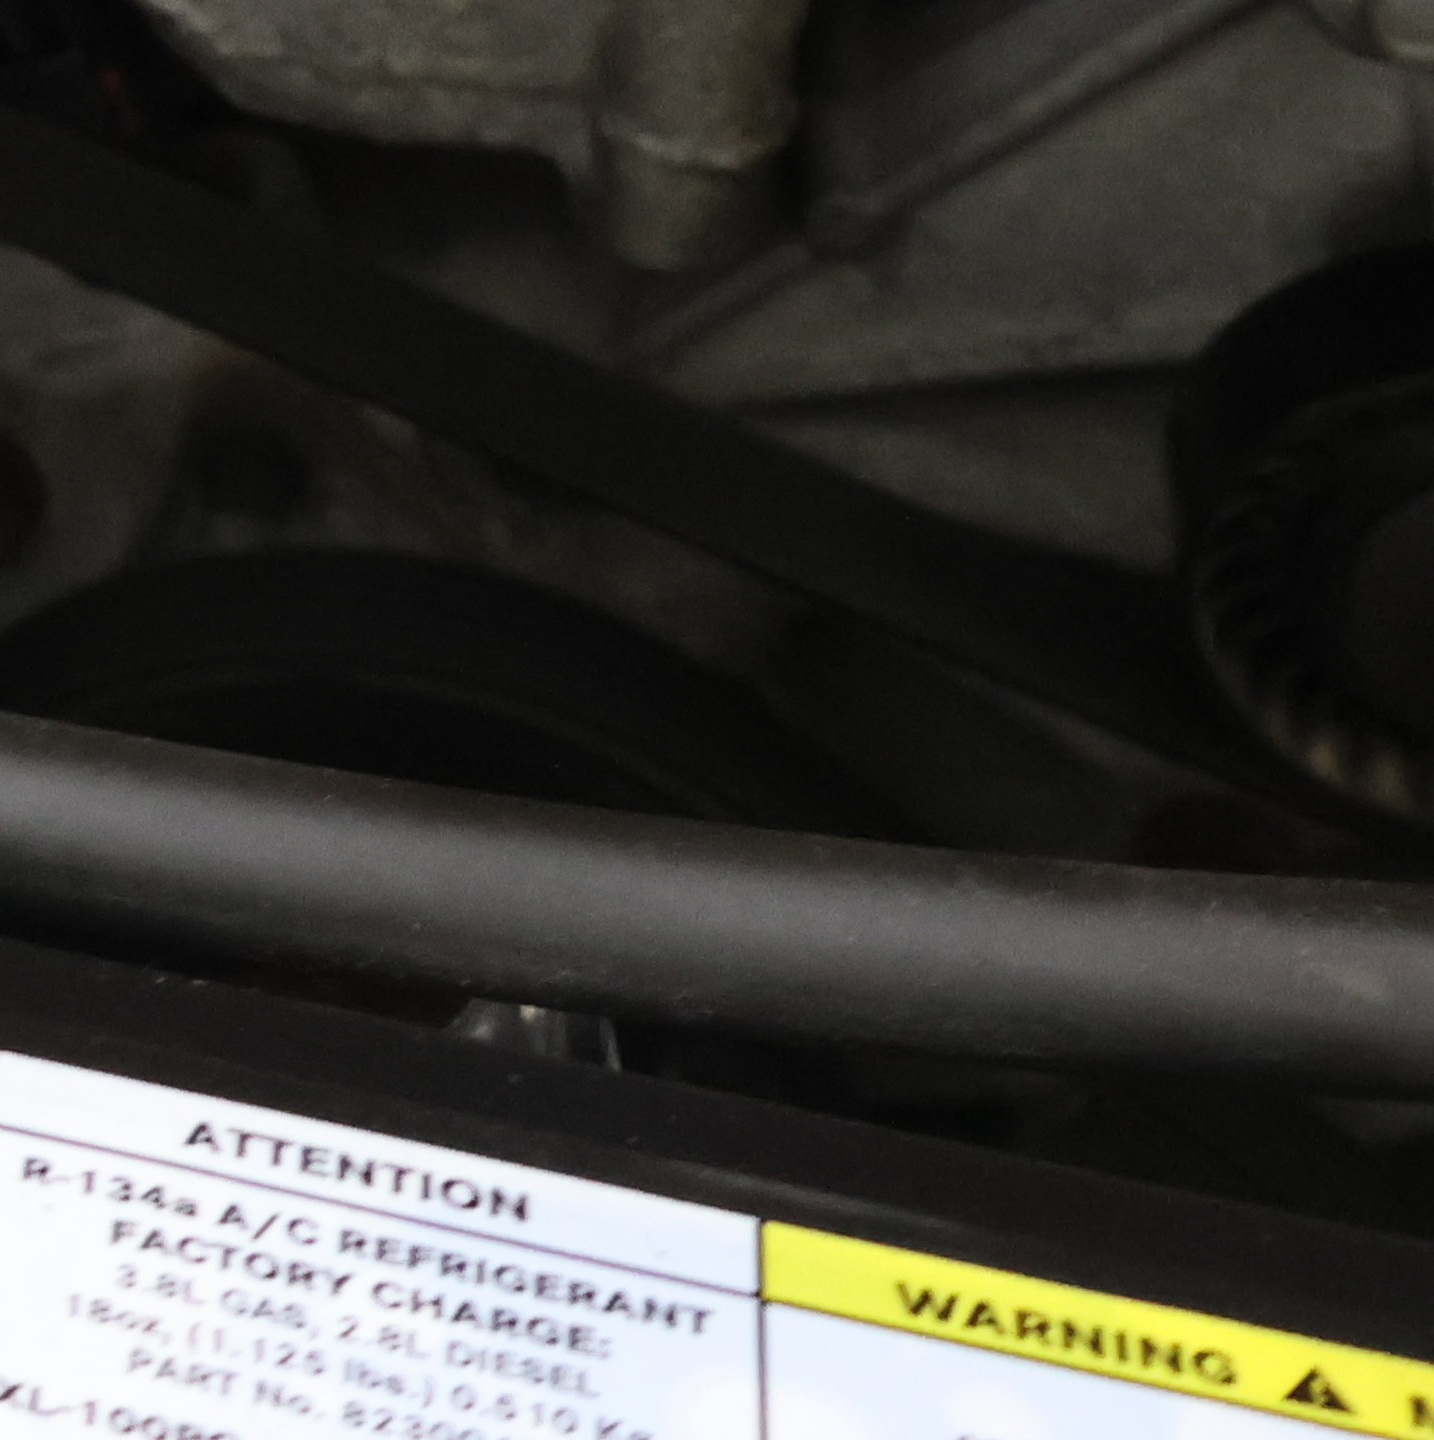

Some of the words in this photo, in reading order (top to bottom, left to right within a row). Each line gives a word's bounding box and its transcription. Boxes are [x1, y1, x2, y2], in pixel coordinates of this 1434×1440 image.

[184, 1121, 530, 1222] ATTENTION
[21, 1156, 199, 1220] R-134a
[218, 1204, 319, 1247] A/C
[337, 1229, 717, 1335] REFRIGERANT
[109, 1219, 353, 1297] FACTORY
[371, 1279, 612, 1361] CHARGE:
[127, 1344, 238, 1396] PART
[446, 1339, 600, 1398] DIESEL
[894, 1281, 1239, 1385] WARNING
